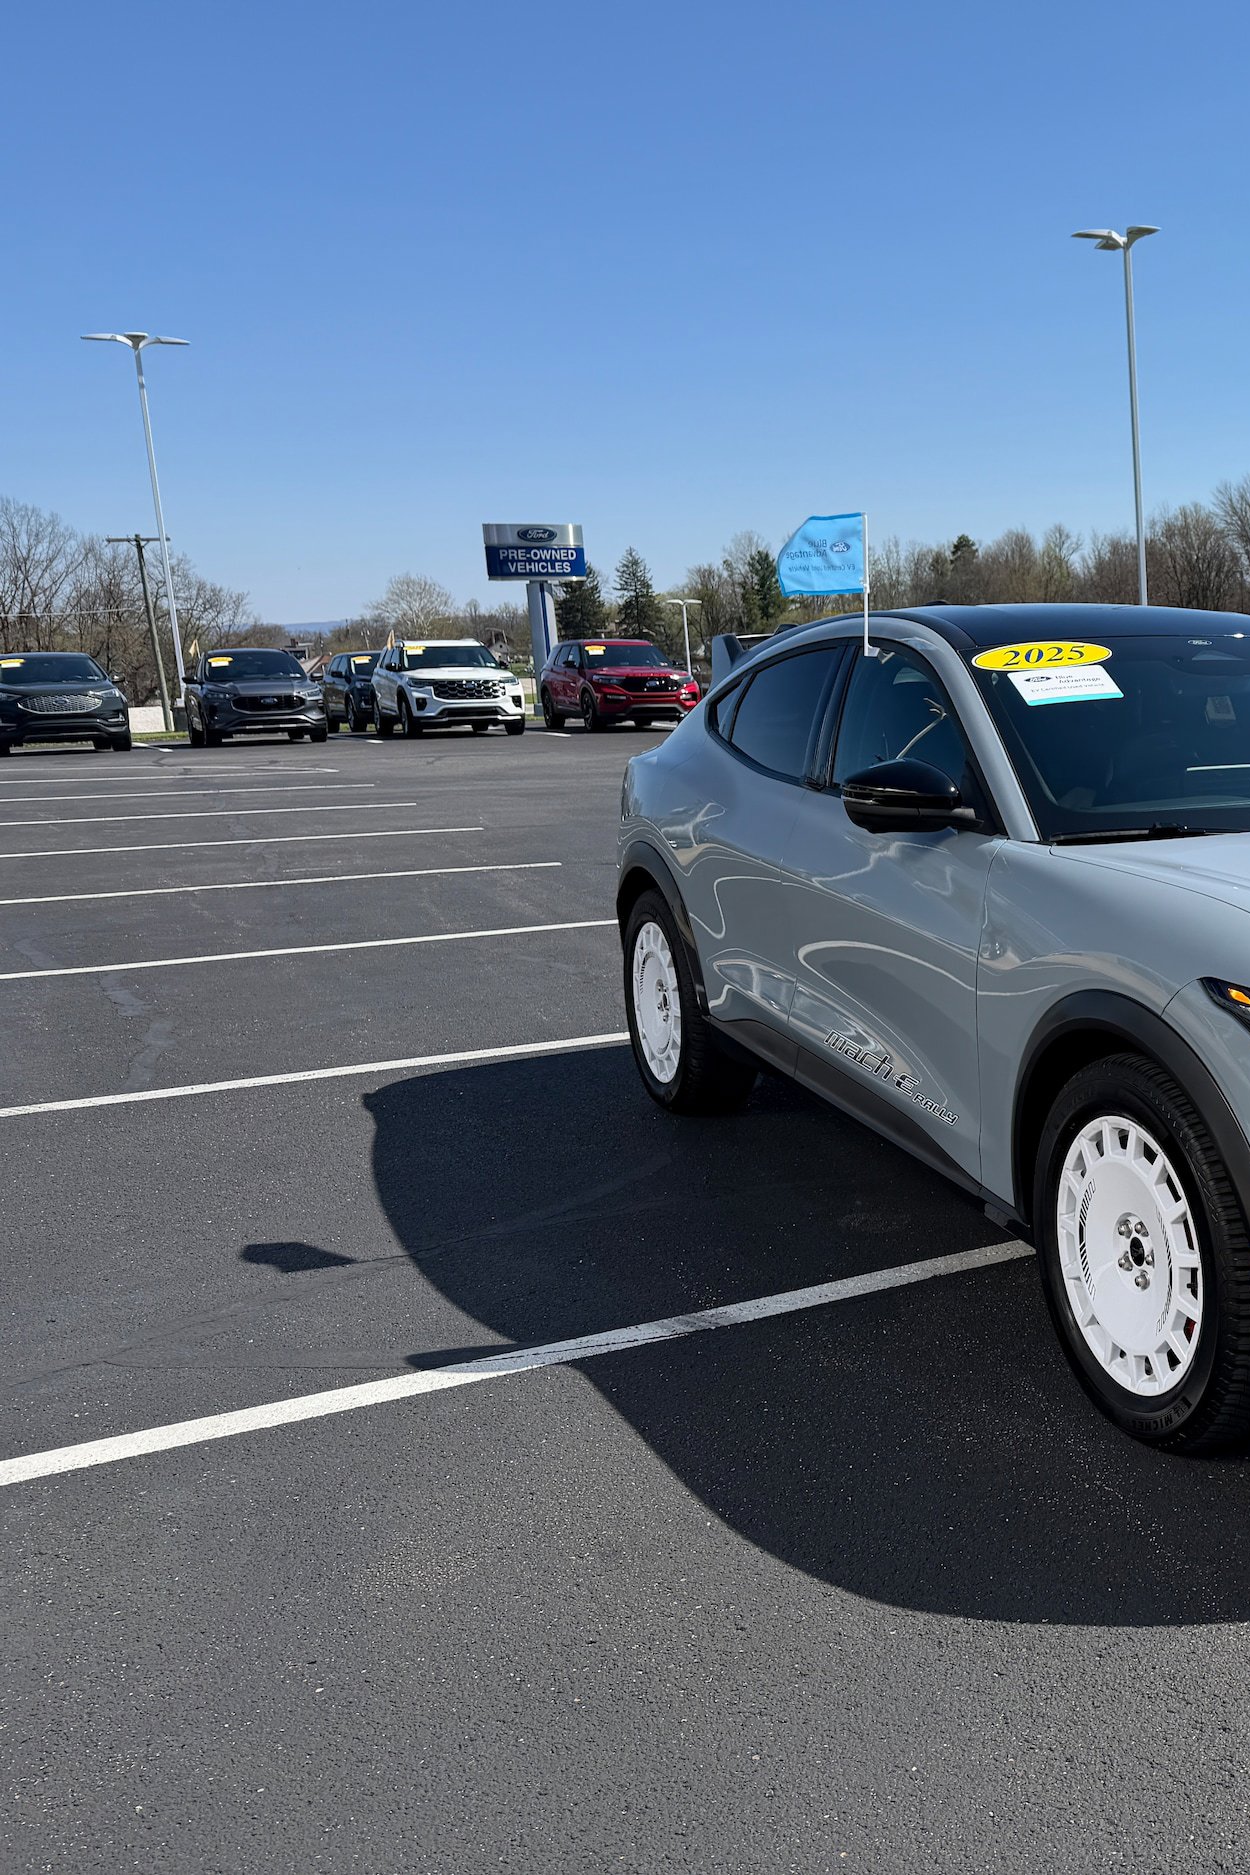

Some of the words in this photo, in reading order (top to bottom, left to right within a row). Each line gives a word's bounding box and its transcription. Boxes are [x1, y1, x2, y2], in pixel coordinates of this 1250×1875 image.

[499, 549, 577, 561] PRE-OWNED
[508, 562, 571, 573] VEHICLES
[1002, 645, 1085, 667] 2025
[912, 1092, 960, 1126] RALLY
